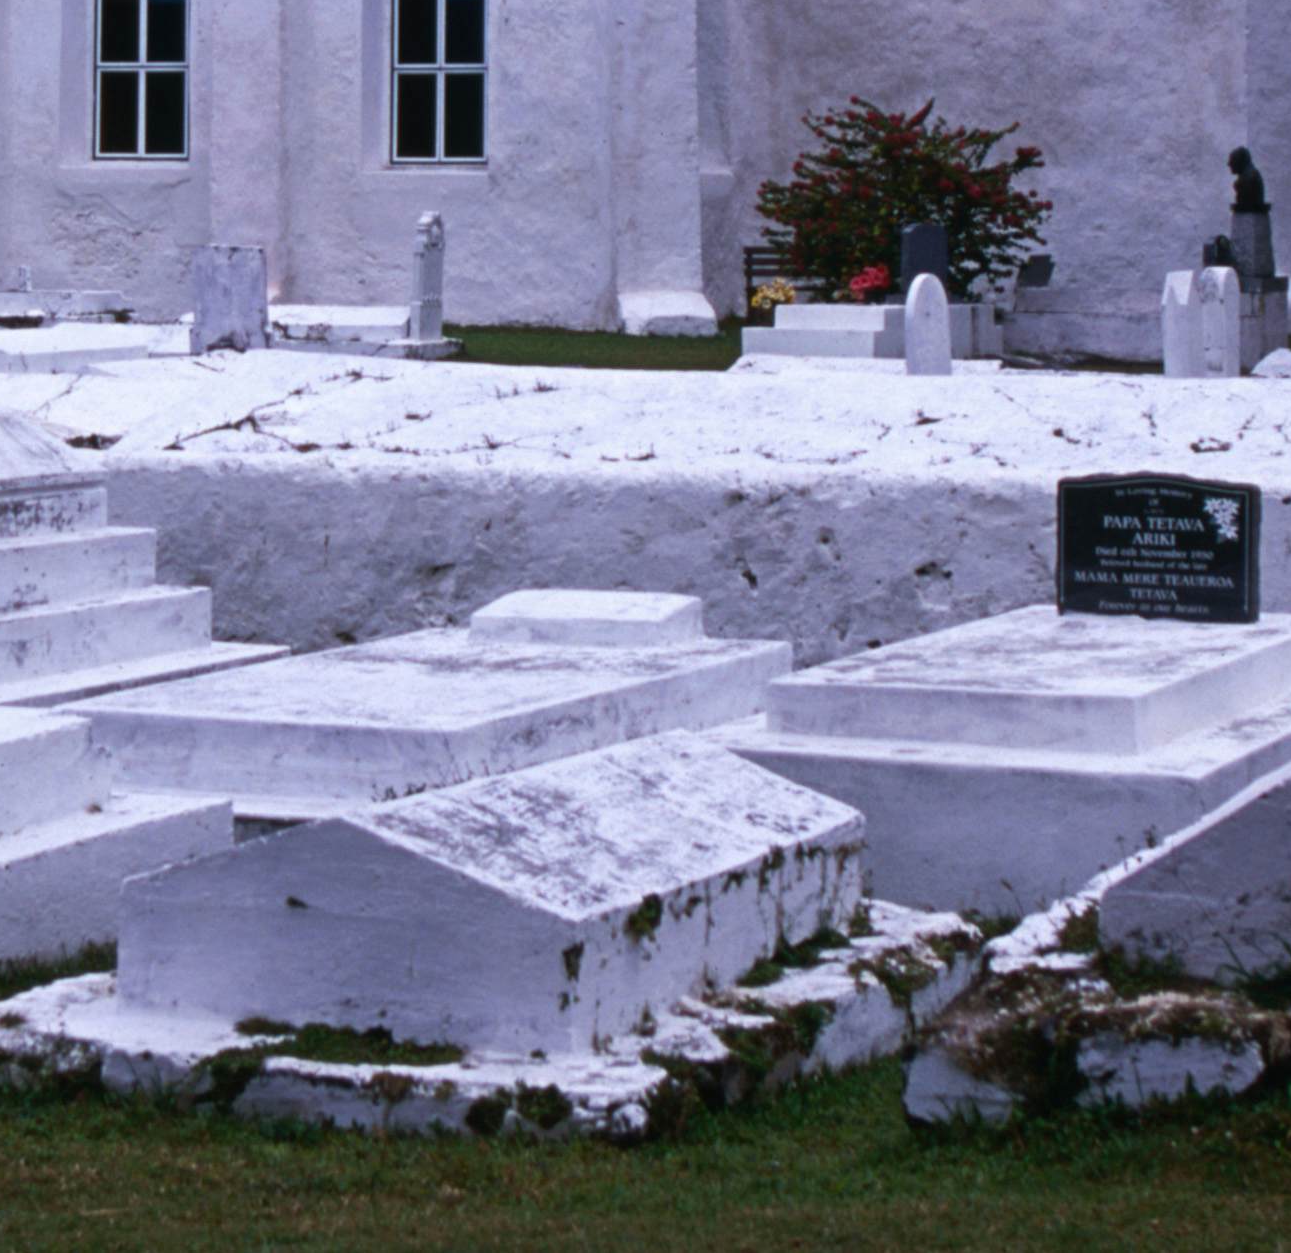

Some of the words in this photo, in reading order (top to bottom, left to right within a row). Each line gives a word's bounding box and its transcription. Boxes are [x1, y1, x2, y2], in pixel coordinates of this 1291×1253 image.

[1103, 515, 1141, 529] PAPA
[1147, 516, 1204, 532] TETAVA
[1132, 532, 1176, 546] ARIKI
[1074, 570, 1118, 583] MAMA
[1129, 587, 1178, 601] TETAVA
